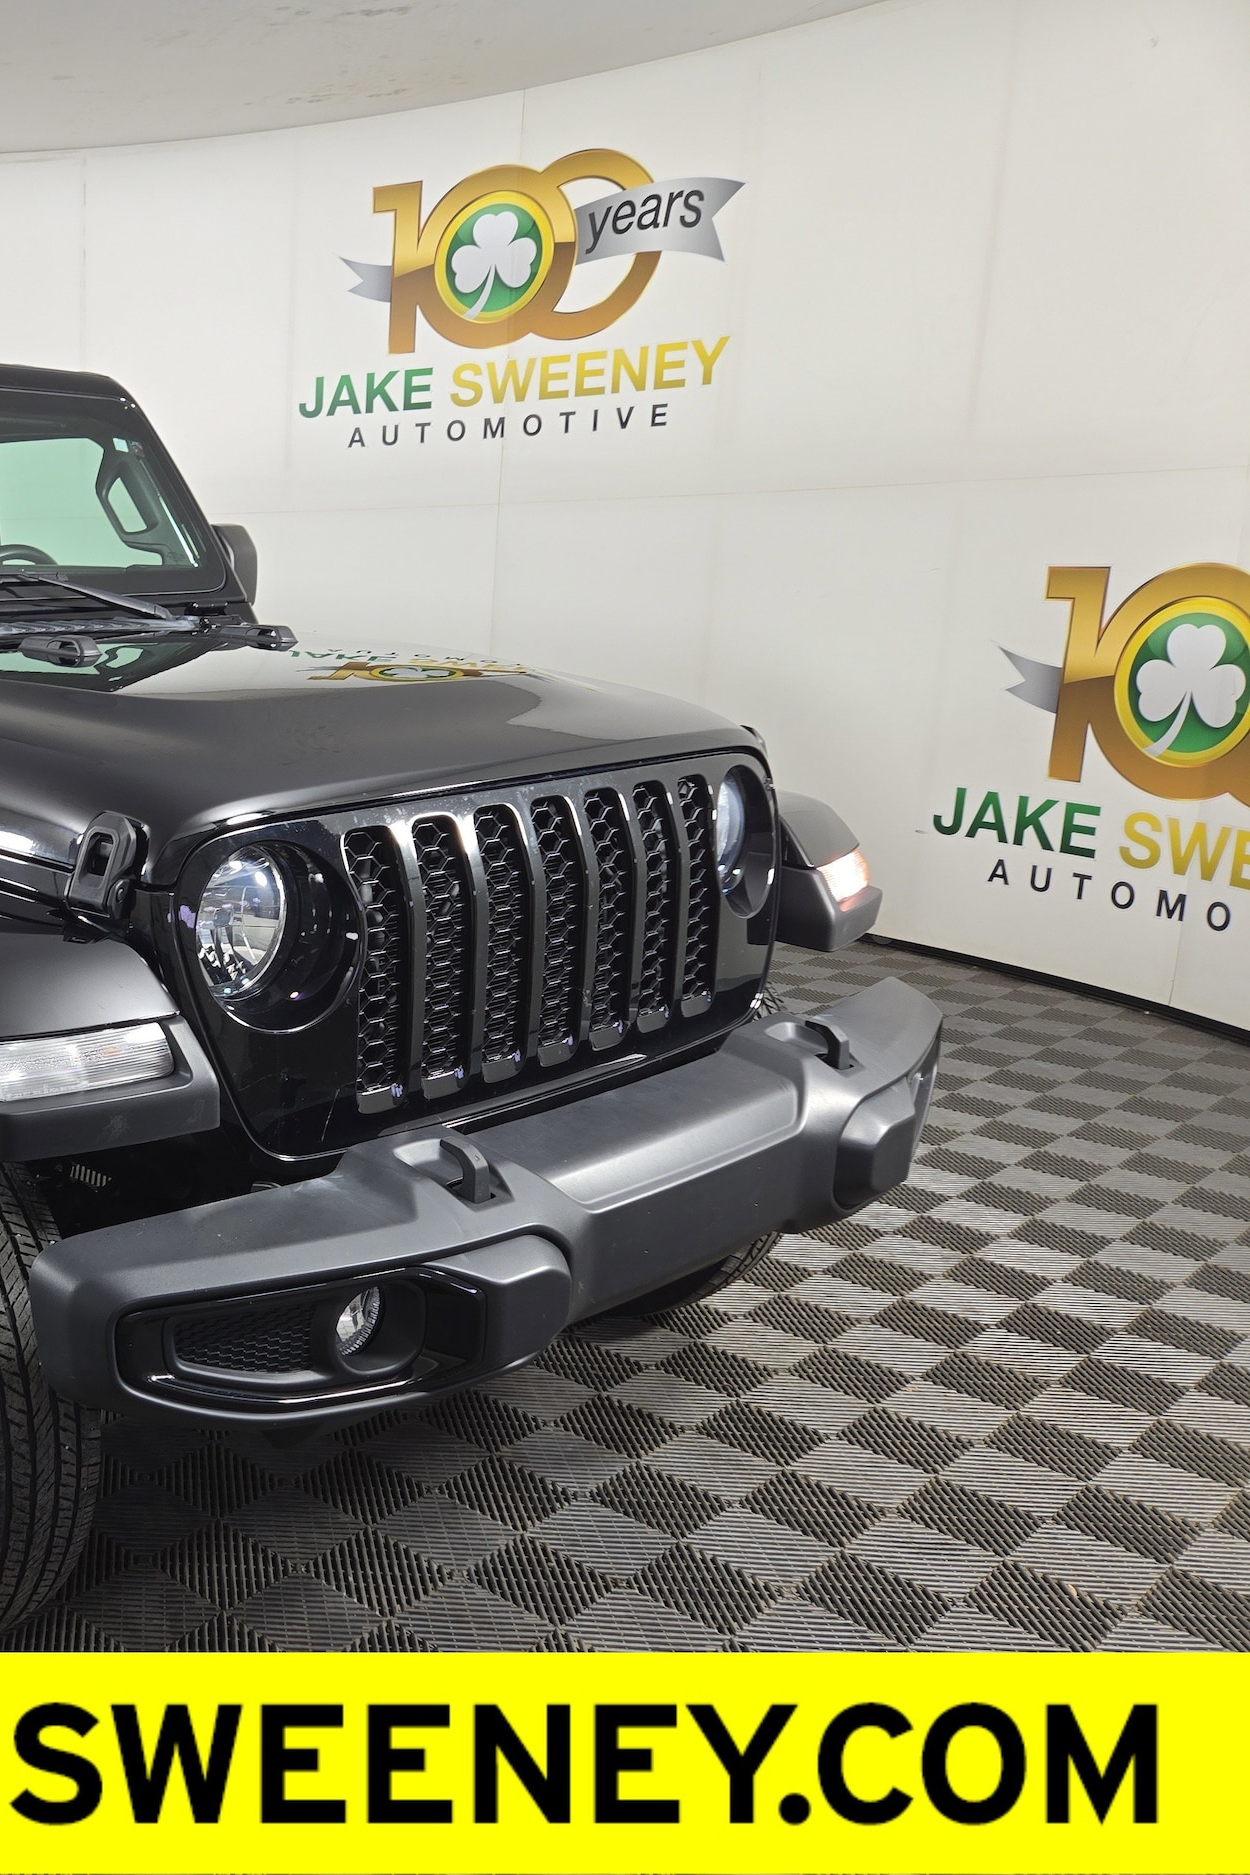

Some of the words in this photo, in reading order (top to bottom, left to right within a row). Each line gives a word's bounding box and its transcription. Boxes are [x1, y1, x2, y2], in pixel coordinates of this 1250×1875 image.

[371, 147, 661, 355] 100
[585, 188, 705, 255] years
[298, 366, 434, 419] JAKE
[450, 335, 731, 409] SWEENEY
[347, 402, 669, 450] AUTOMOTIVE
[933, 787, 1101, 859] JAKE
[987, 858, 1232, 932] AUTOMO
